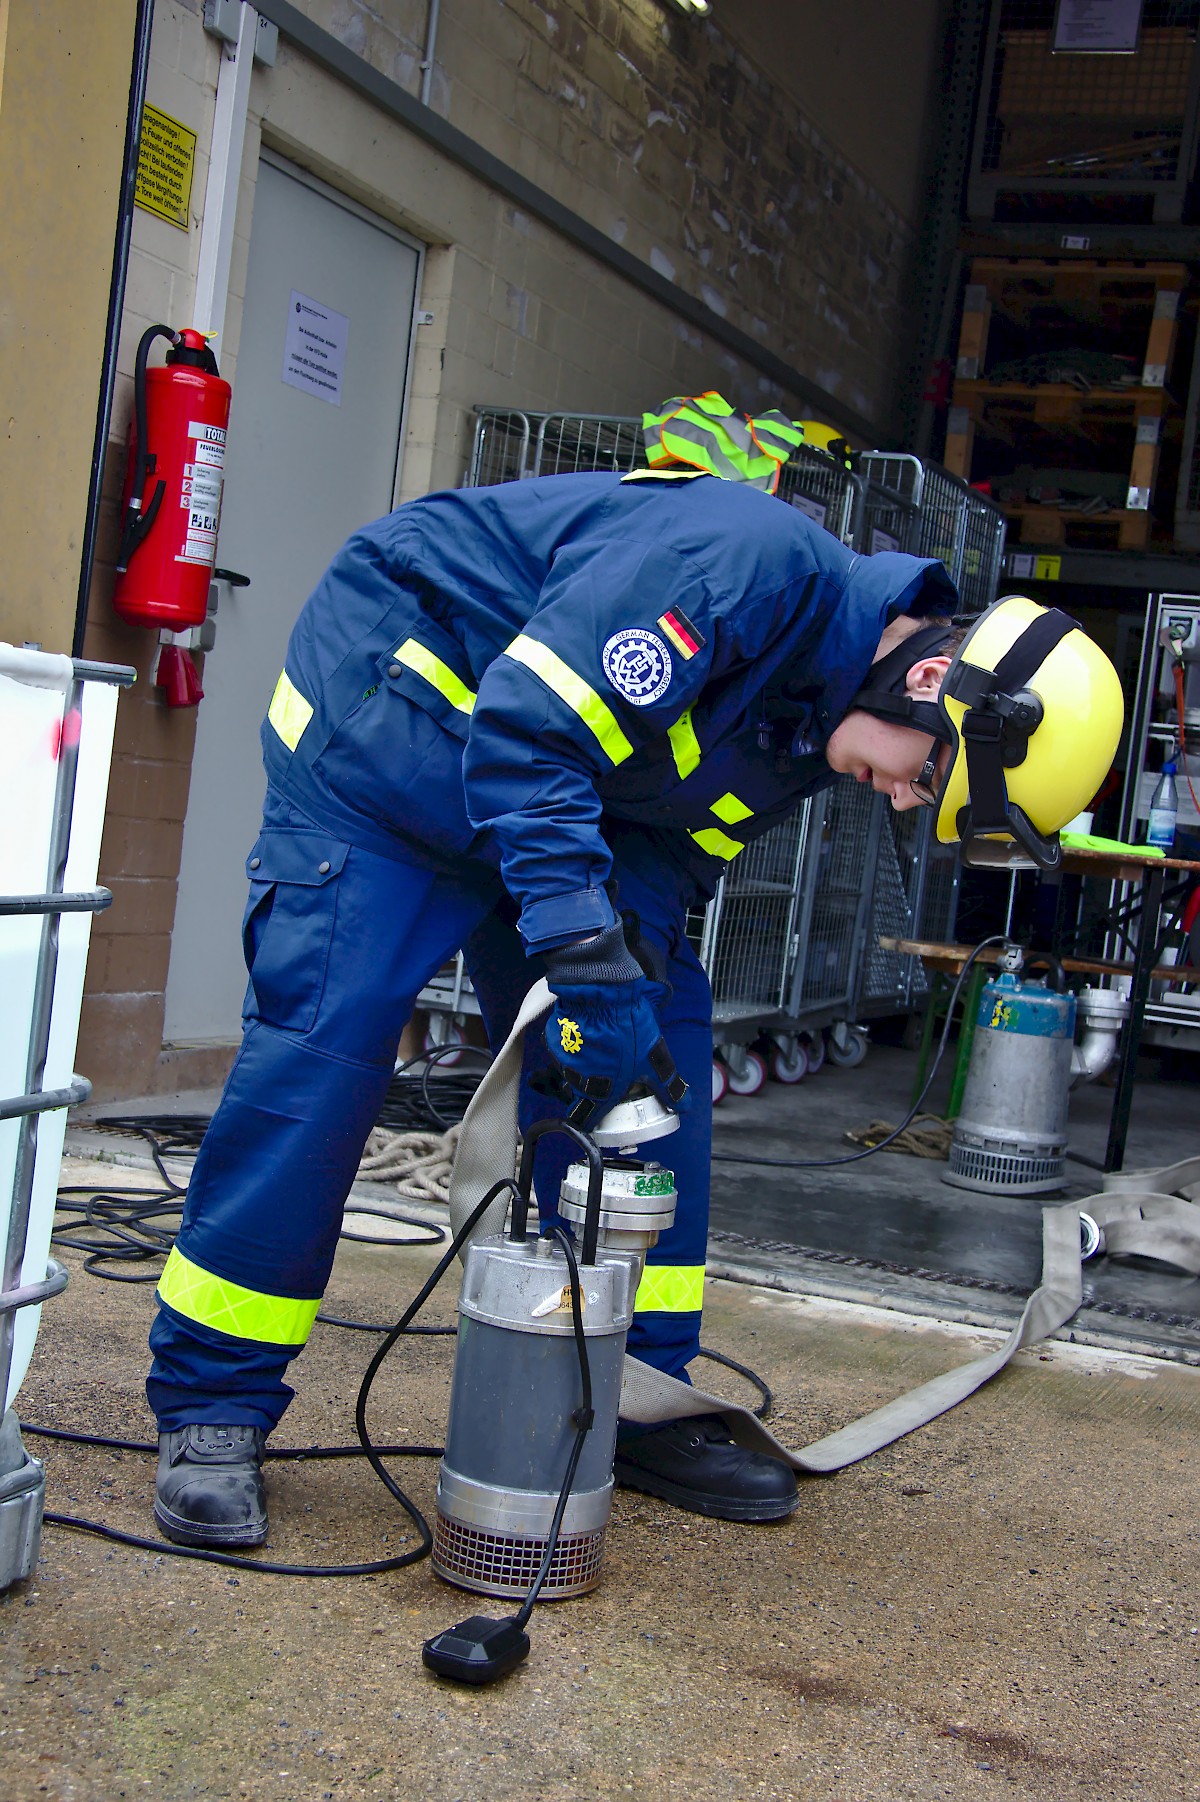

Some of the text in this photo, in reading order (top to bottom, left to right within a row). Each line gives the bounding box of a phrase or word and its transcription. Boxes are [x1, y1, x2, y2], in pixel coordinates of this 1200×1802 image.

[148, 127, 162, 142] Feuer
[163, 138, 172, 148] und
[152, 154, 160, 166] Bei
[161, 160, 184, 180] laufenden
[149, 165, 168, 183] besteht
[169, 178, 182, 191] durch
[141, 186, 152, 198] Tore
[153, 194, 163, 205] weit
[188, 466, 192, 476] 1
[185, 481, 192, 492] 2
[182, 497, 190, 507] 3
[616, 631, 671, 698] GERMAN FEDERAL AGENCY
